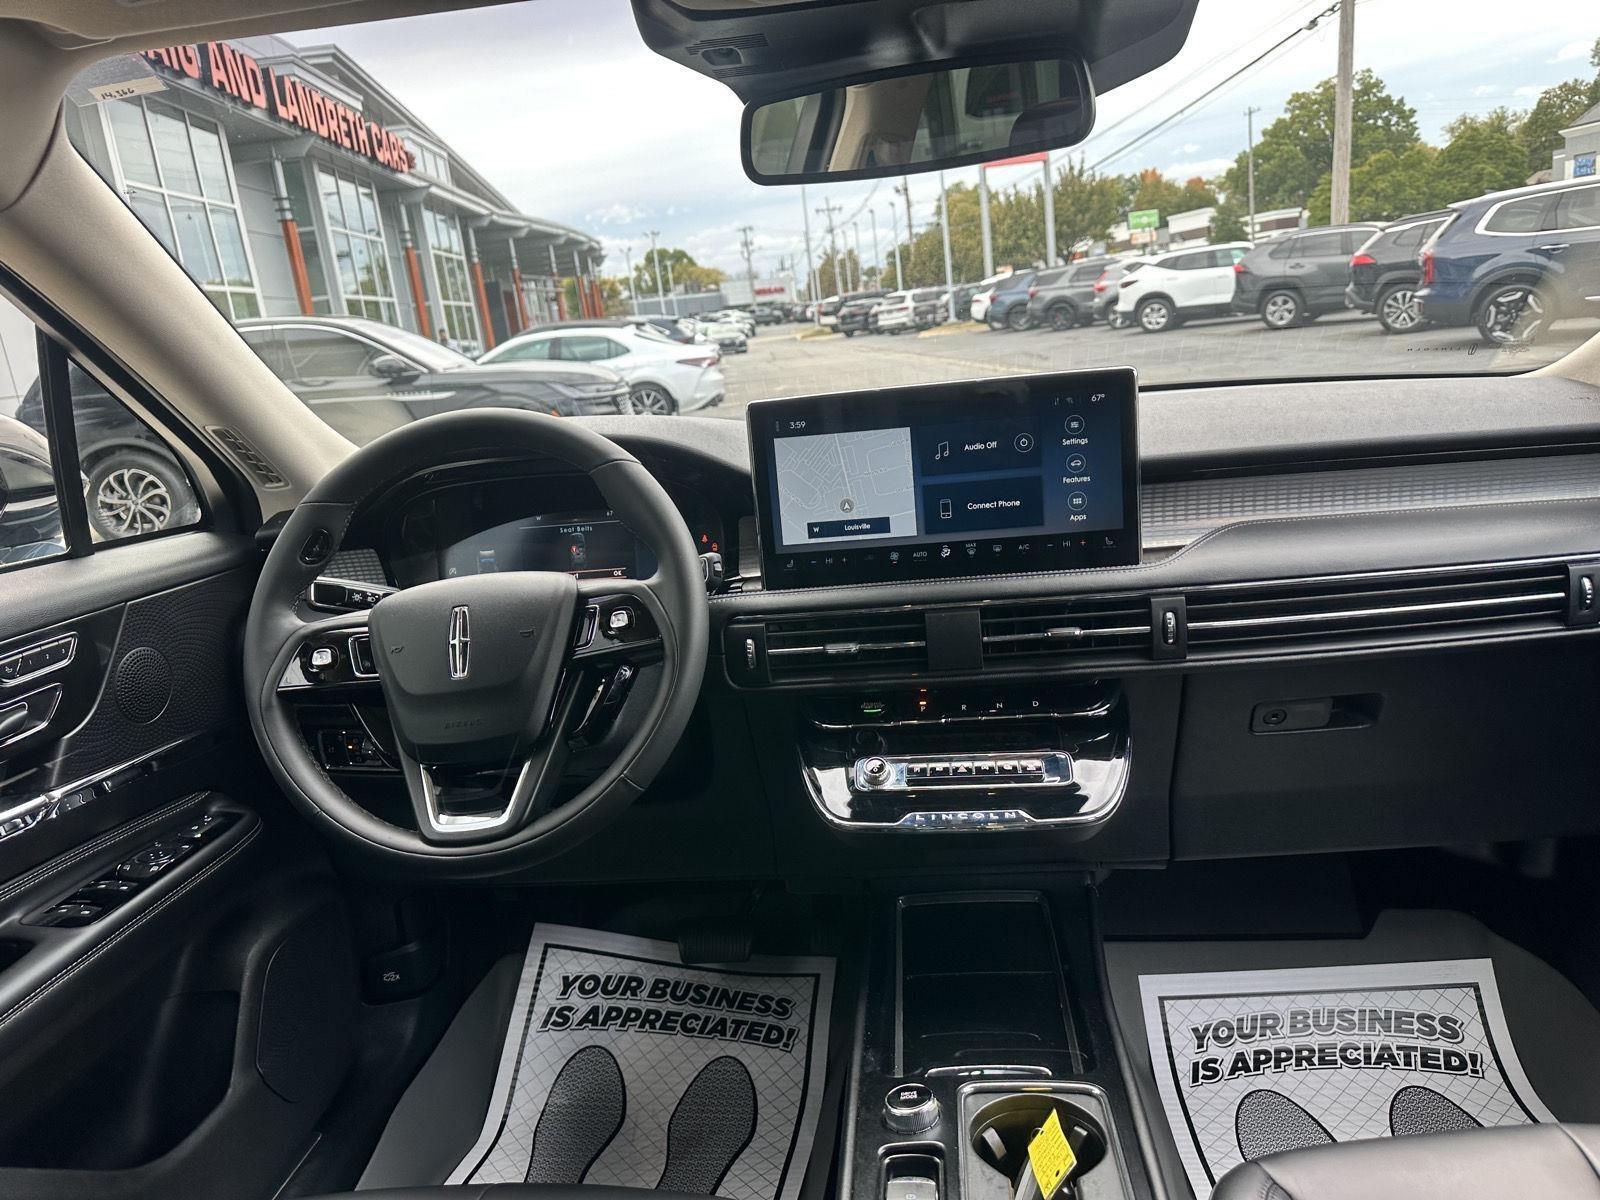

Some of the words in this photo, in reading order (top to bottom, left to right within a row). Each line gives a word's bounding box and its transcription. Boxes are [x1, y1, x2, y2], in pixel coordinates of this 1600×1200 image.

[208, 40, 267, 109] AND
[269, 66, 371, 157] LANDRETH
[371, 121, 412, 173] CARS
[789, 420, 806, 429] 3:59
[964, 442, 985, 451] Audio
[986, 441, 997, 449] Off
[1062, 437, 1088, 447] Settings
[1062, 475, 1091, 484] Features
[967, 500, 997, 510] Connect
[998, 499, 1021, 508] Phone
[1069, 512, 1087, 522] Apps
[559, 526, 575, 534] Seat
[577, 525, 593, 533] Belts
[844, 522, 871, 531] Louisville
[1018, 543, 1030, 551] A/C
[1062, 540, 1071, 548] HI
[912, 551, 928, 559] AUTO
[916, 811, 1017, 820] LINCOLN
[557, 973, 647, 1000] YOUR
[647, 976, 796, 1019] BUSINESS
[538, 1004, 577, 1032] IS
[574, 1003, 799, 1052] APPRECIATED!
[1190, 1011, 1286, 1052] YOUR
[1286, 1006, 1464, 1044] BUSINESS
[1189, 1056, 1225, 1087] IS
[1223, 1041, 1484, 1079] APPRECIATED!
